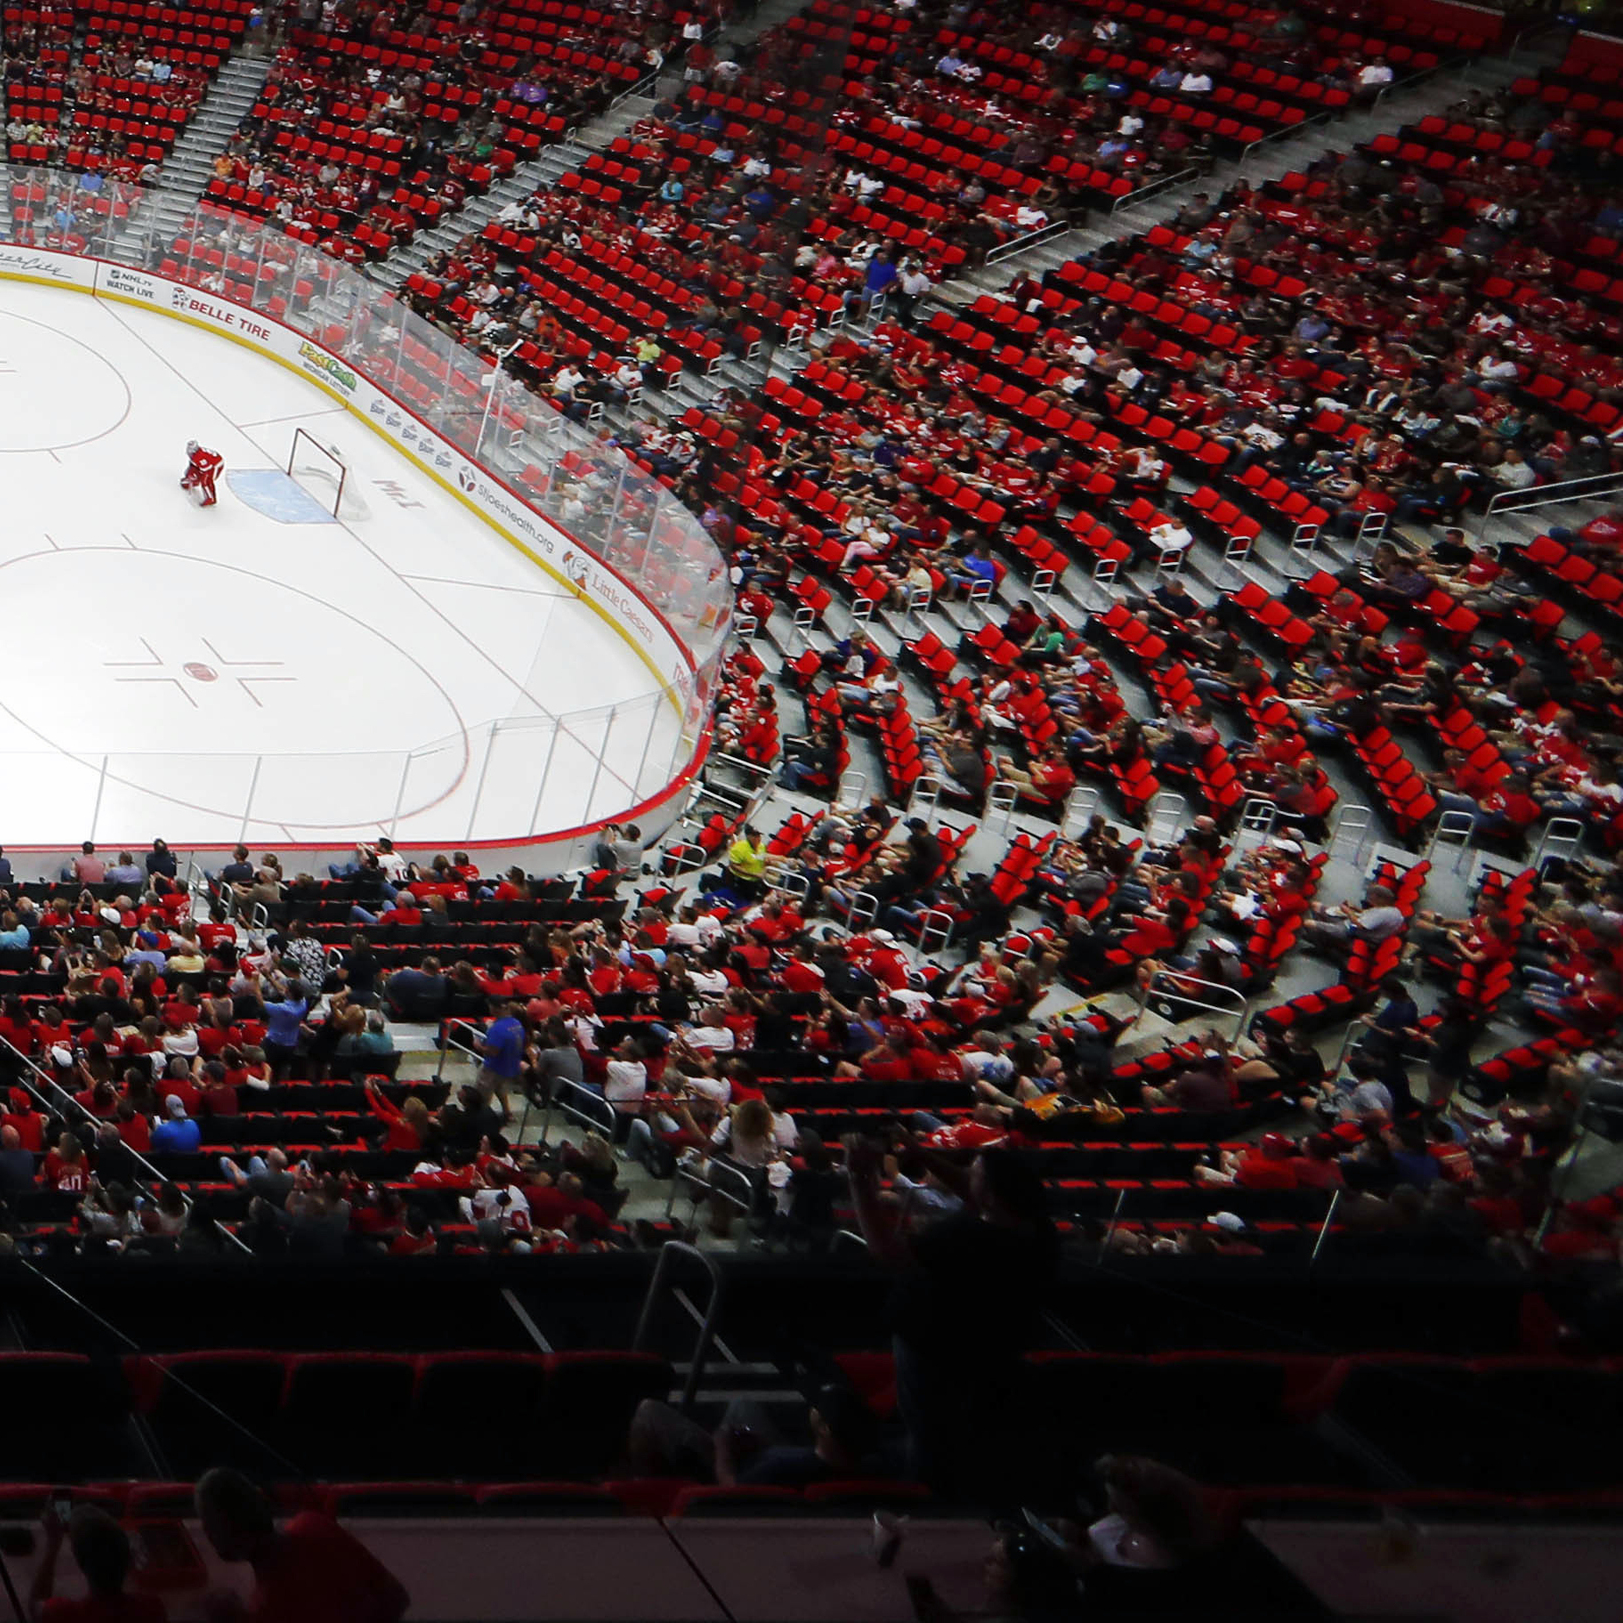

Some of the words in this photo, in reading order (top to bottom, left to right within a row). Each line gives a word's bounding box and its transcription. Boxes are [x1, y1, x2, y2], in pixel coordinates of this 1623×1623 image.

[107, 278, 135, 293] WATCH
[137, 288, 154, 300] LIVE
[189, 299, 234, 325] BELLE
[239, 319, 271, 341] TIRE
[591, 574, 620, 607] Little
[619, 597, 655, 643] Caesars
